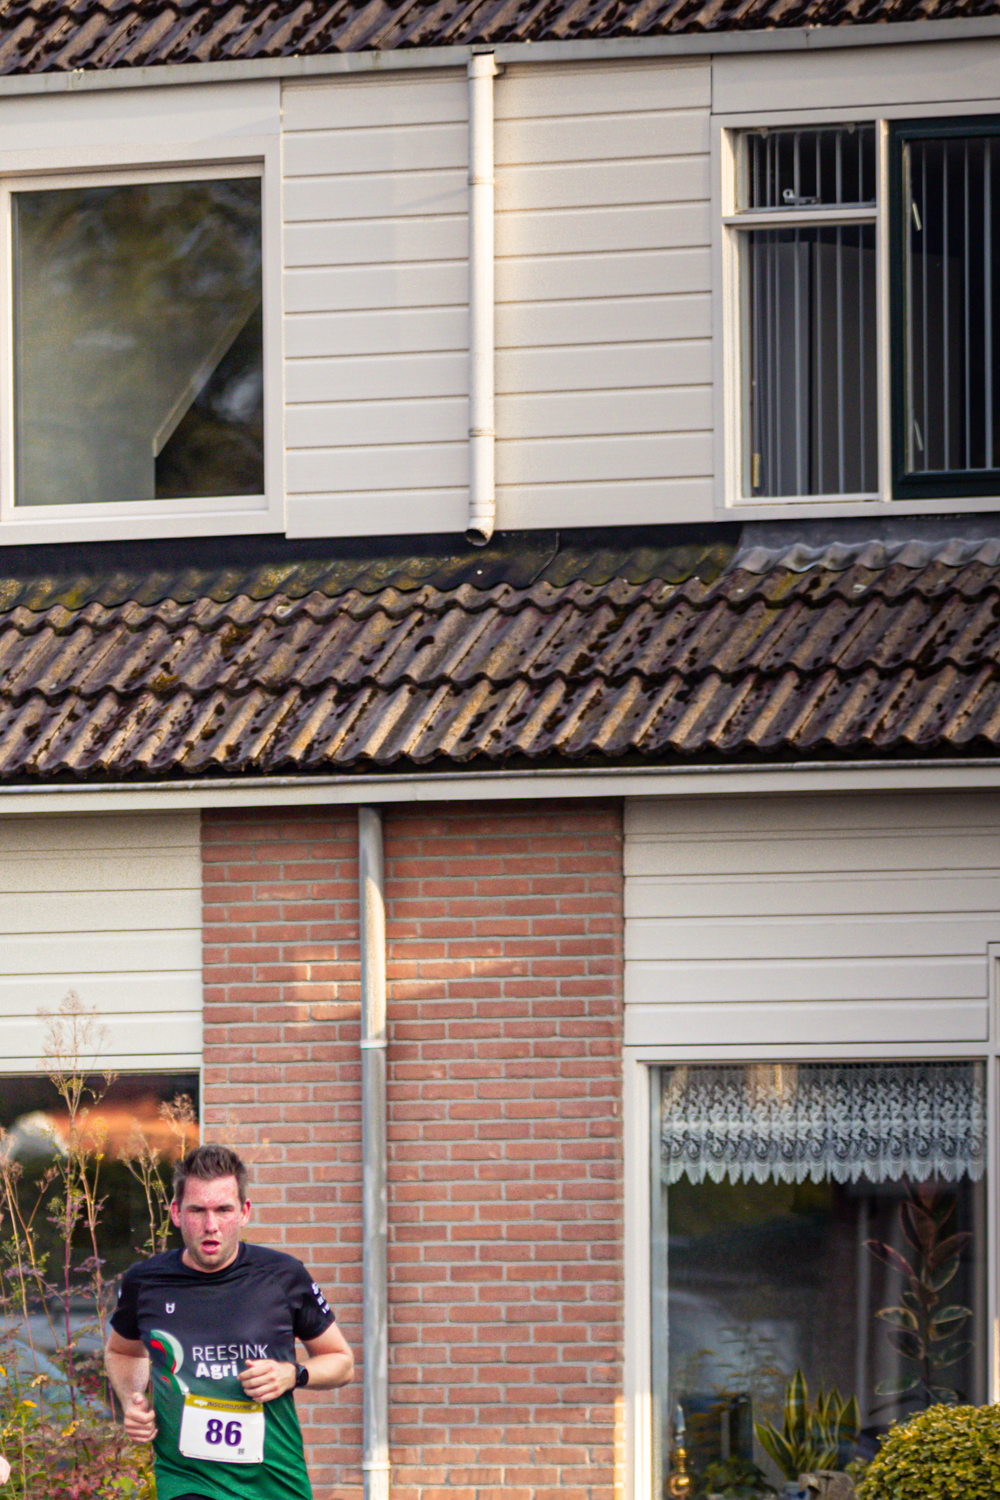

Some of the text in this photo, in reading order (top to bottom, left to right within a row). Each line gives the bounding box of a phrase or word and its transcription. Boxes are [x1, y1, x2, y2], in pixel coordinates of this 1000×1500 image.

[192, 1344, 269, 1362] REESINK
[195, 1361, 239, 1380] Agri
[204, 1418, 243, 1448] 86
